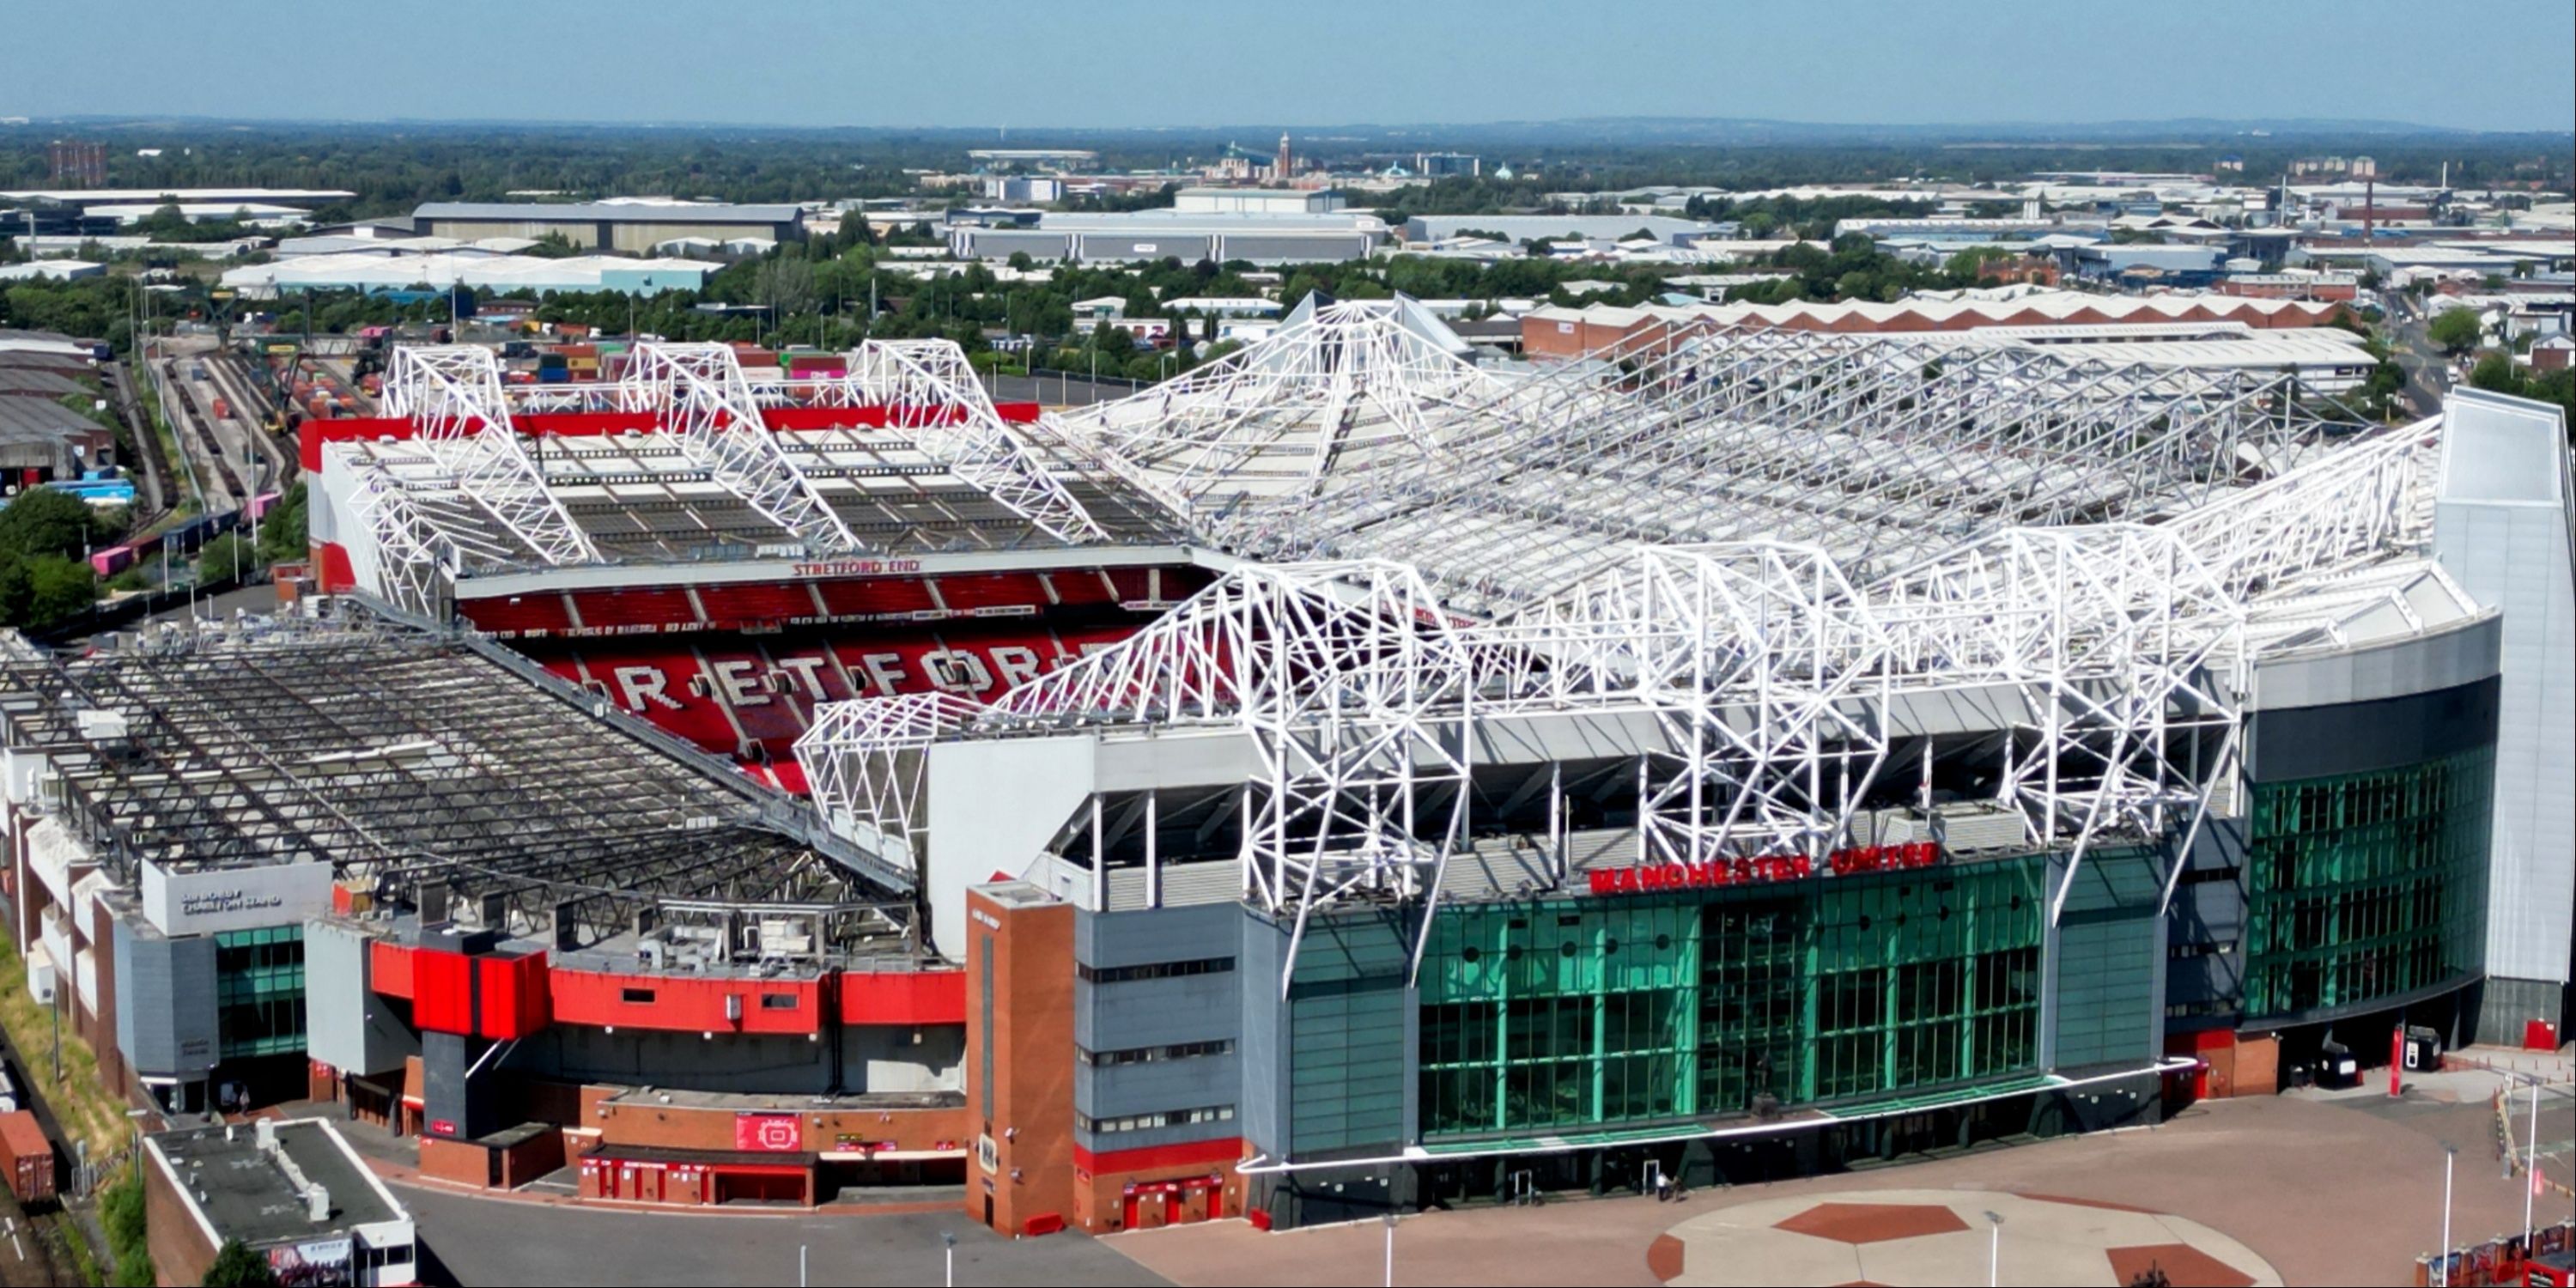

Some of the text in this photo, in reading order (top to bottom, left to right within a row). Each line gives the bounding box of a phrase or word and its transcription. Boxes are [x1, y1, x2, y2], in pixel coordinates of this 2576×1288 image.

[793, 559, 920, 576] STRETFORD END
[1589, 841, 1940, 896] MANCHESTER UNITED
